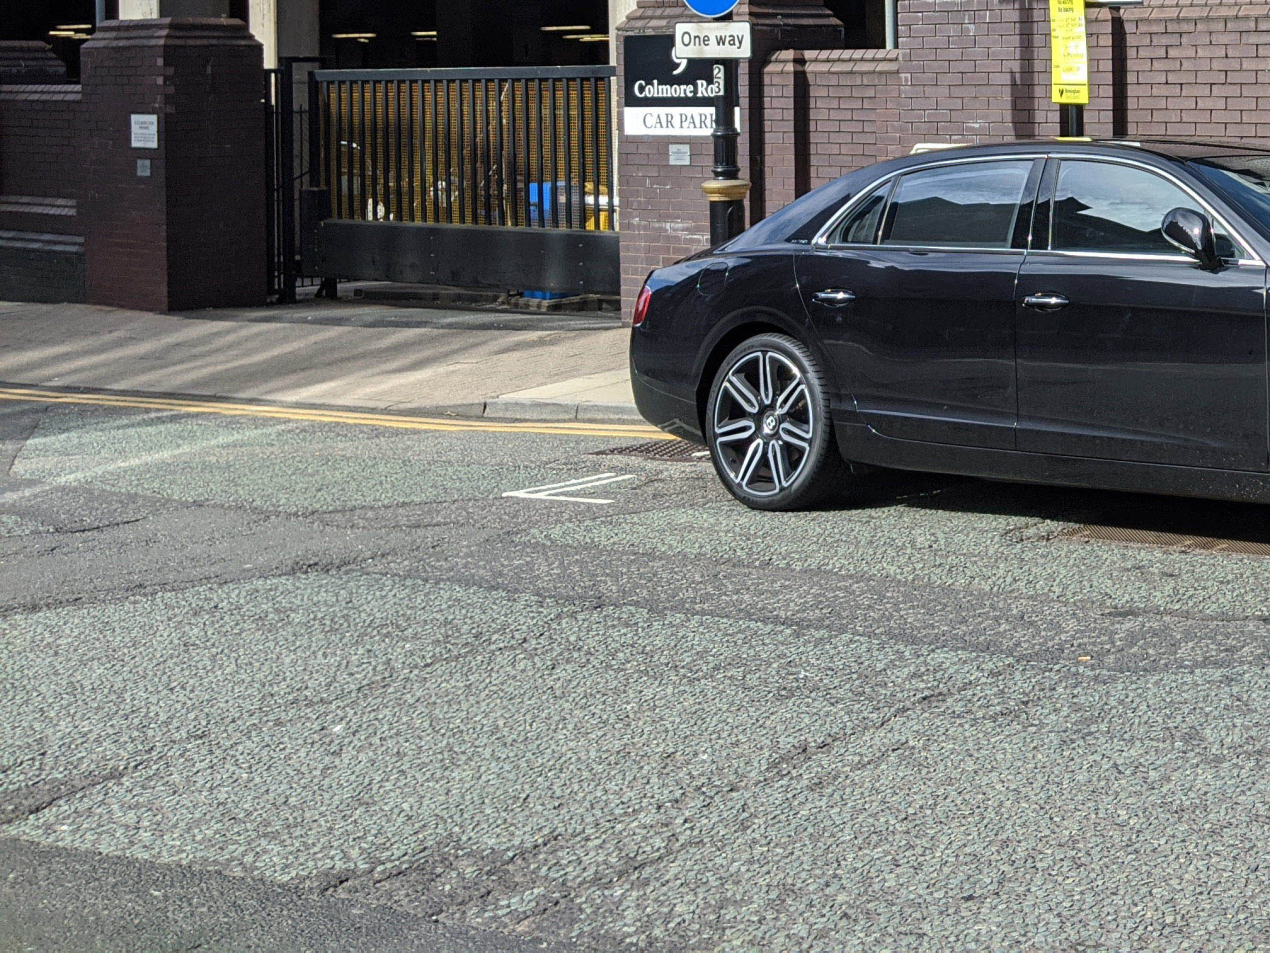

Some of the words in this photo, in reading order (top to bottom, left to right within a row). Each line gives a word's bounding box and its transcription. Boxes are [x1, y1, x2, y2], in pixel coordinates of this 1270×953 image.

[681, 31, 710, 47] One
[715, 34, 745, 49] way
[634, 79, 694, 98] Colmore
[642, 112, 675, 129] CAR
